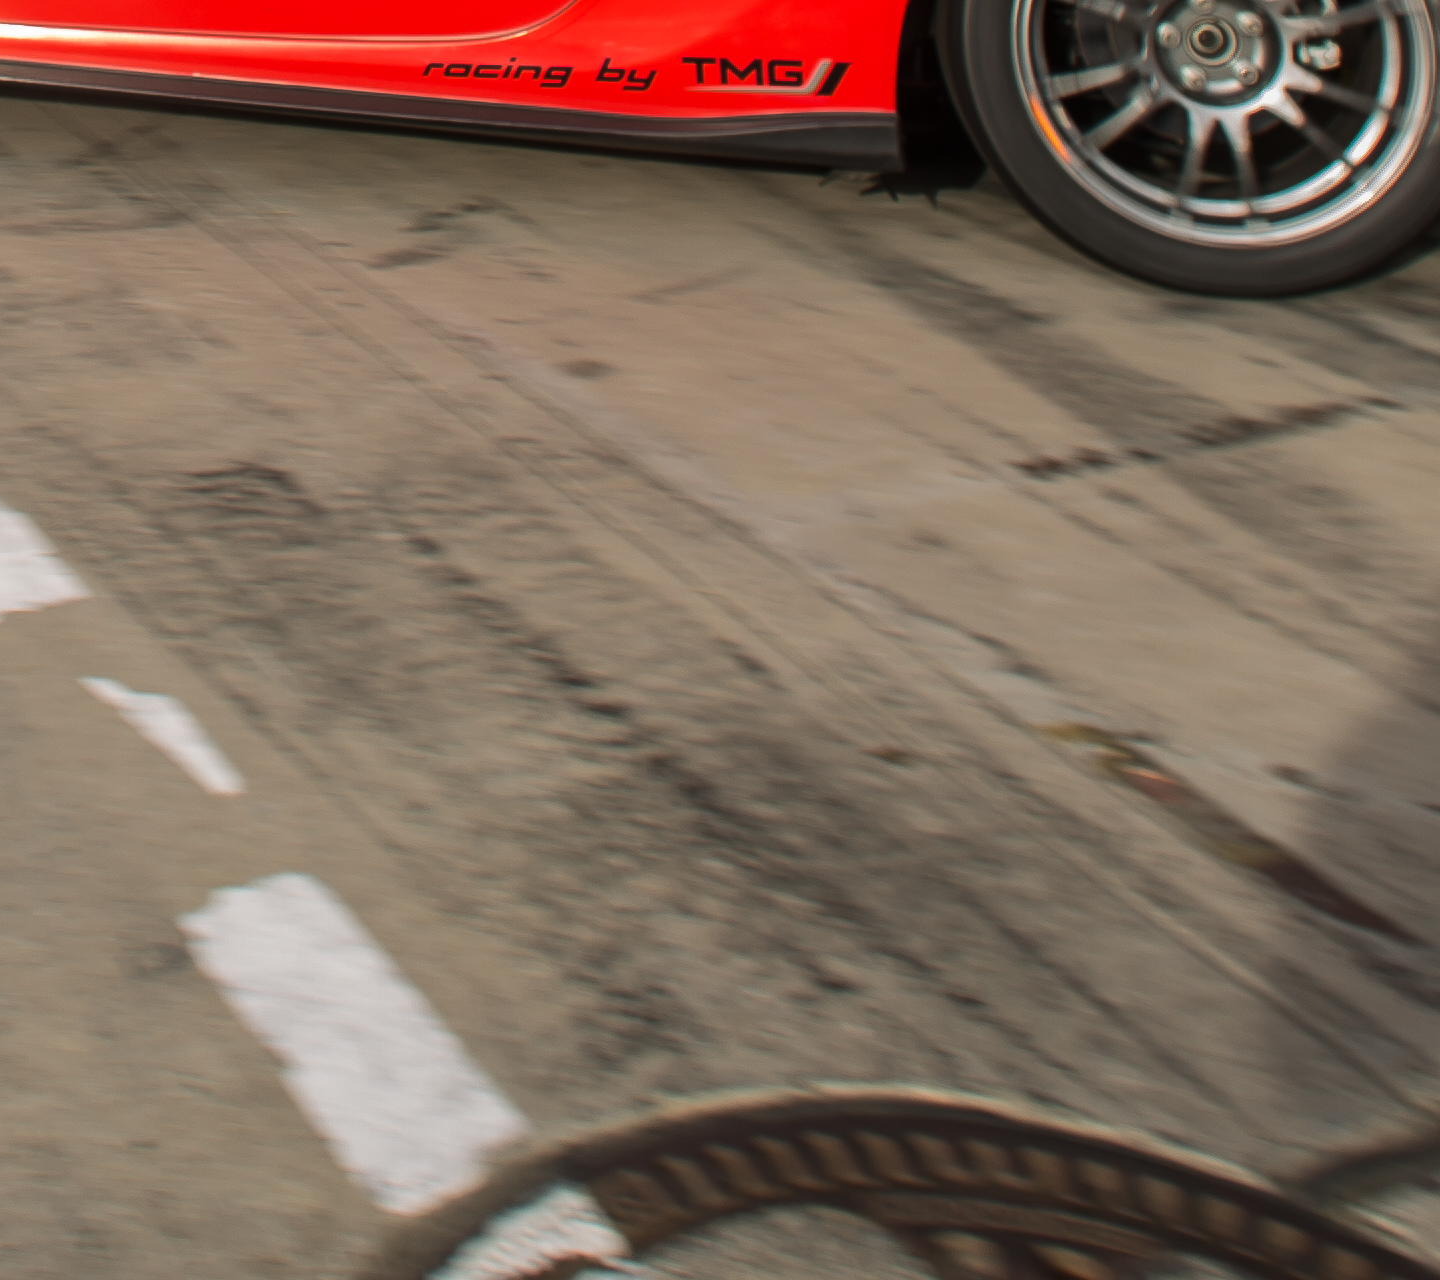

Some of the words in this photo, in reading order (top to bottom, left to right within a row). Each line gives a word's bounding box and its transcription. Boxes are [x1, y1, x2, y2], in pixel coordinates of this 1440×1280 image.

[422, 57, 575, 89] racing
[595, 58, 658, 92] by
[681, 57, 804, 88] TMG
